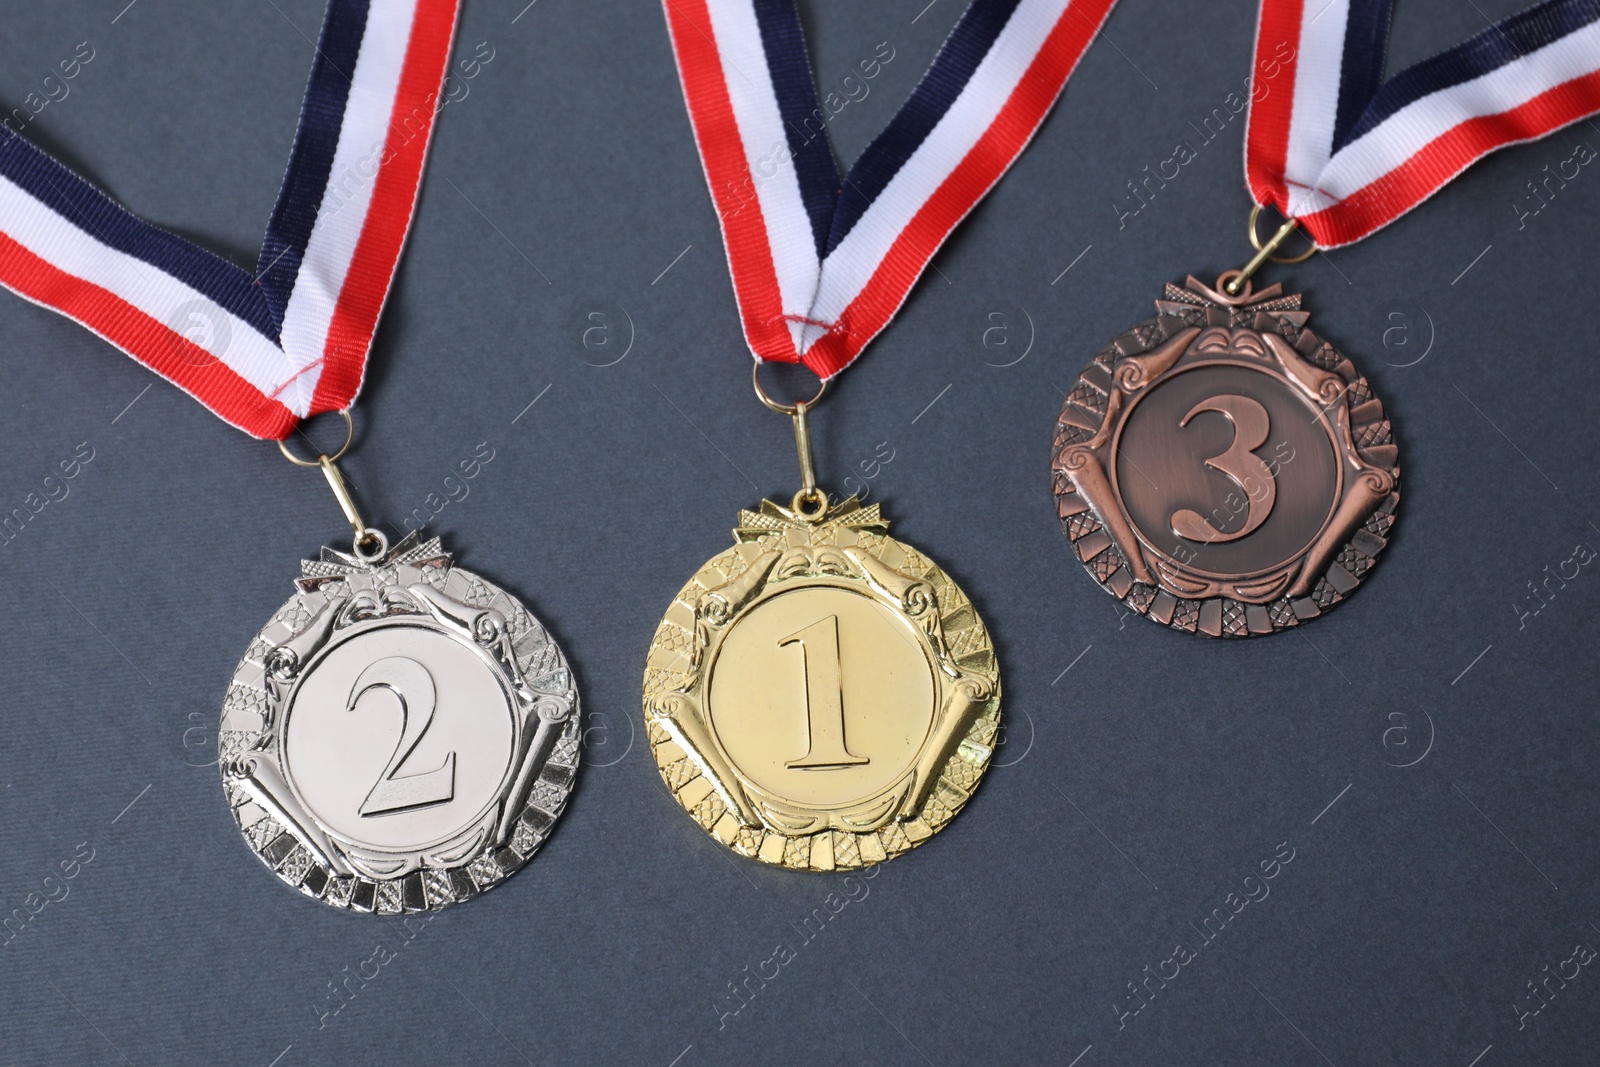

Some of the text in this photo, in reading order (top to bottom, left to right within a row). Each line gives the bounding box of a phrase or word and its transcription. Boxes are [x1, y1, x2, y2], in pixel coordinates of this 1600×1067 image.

[1170, 394, 1276, 542] 3
[346, 655, 456, 817] 2
[777, 613, 870, 769] 1
